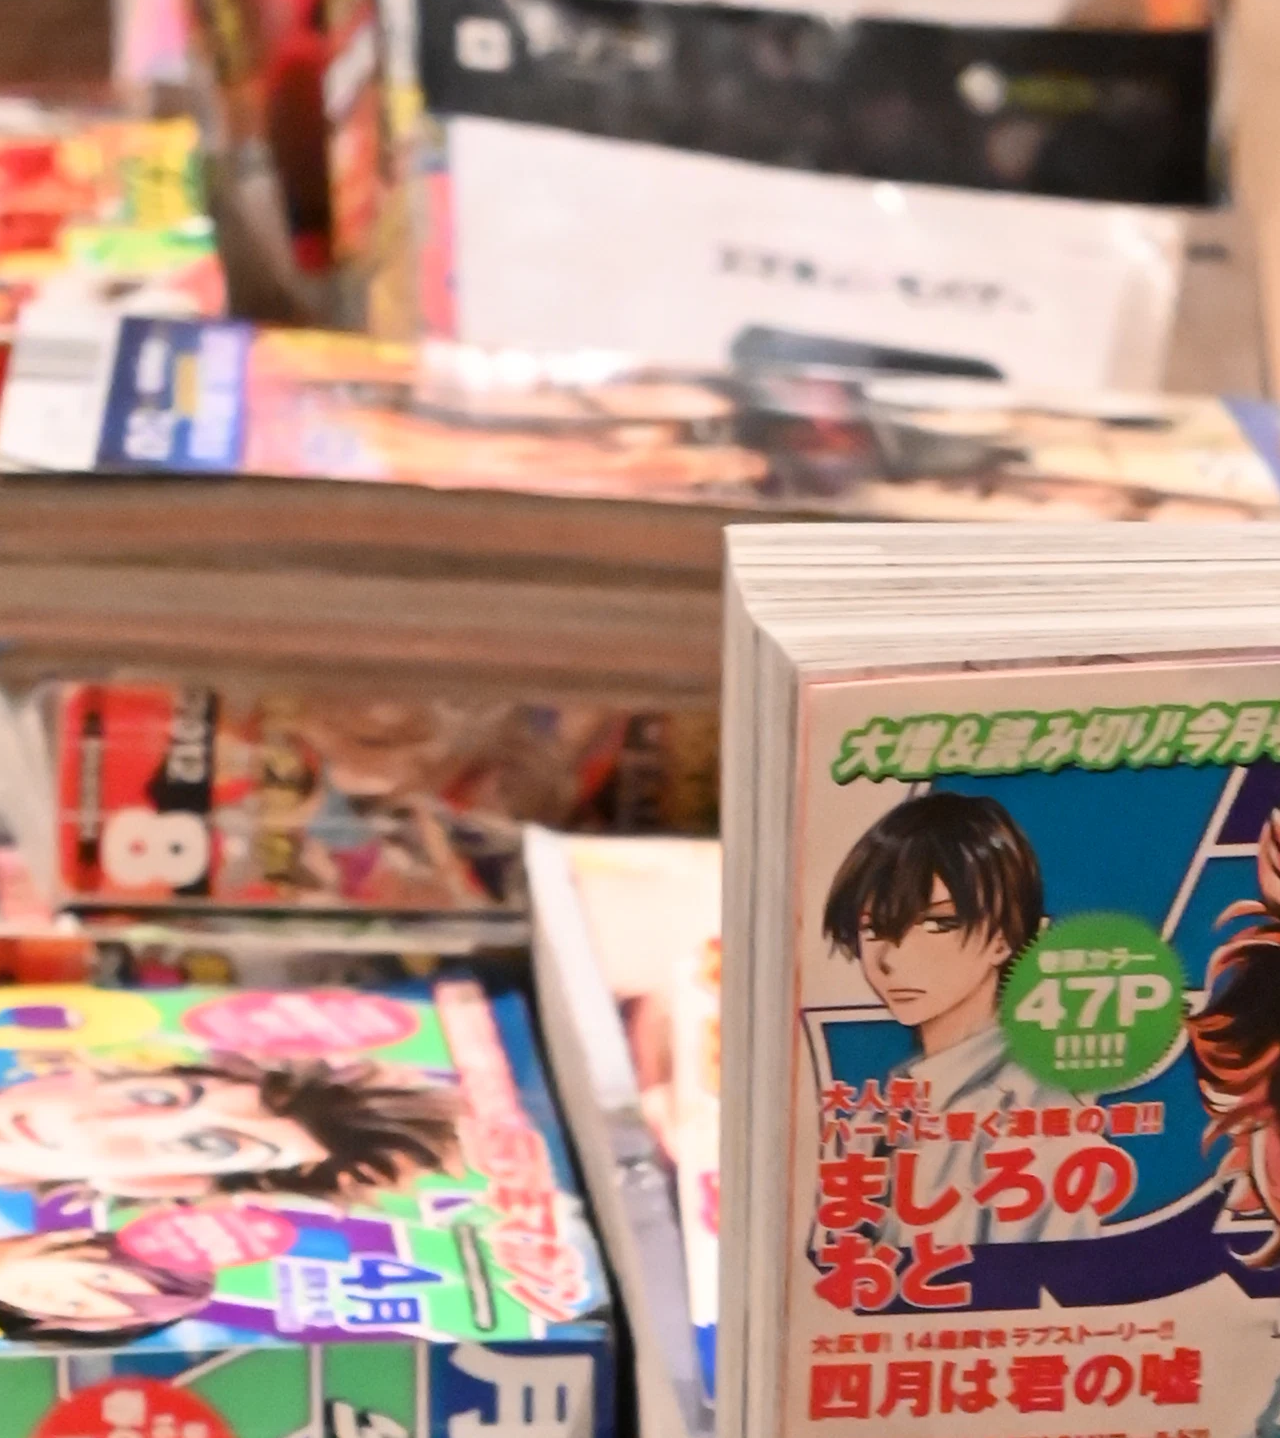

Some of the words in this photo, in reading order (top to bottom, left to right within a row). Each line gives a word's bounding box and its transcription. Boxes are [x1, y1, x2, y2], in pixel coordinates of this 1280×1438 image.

[1014, 973, 1172, 1030] 47P
[817, 1144, 1138, 1230] ましろの
[812, 1232, 974, 1312] おと
[808, 1346, 1203, 1422] 四月は君の嘘
